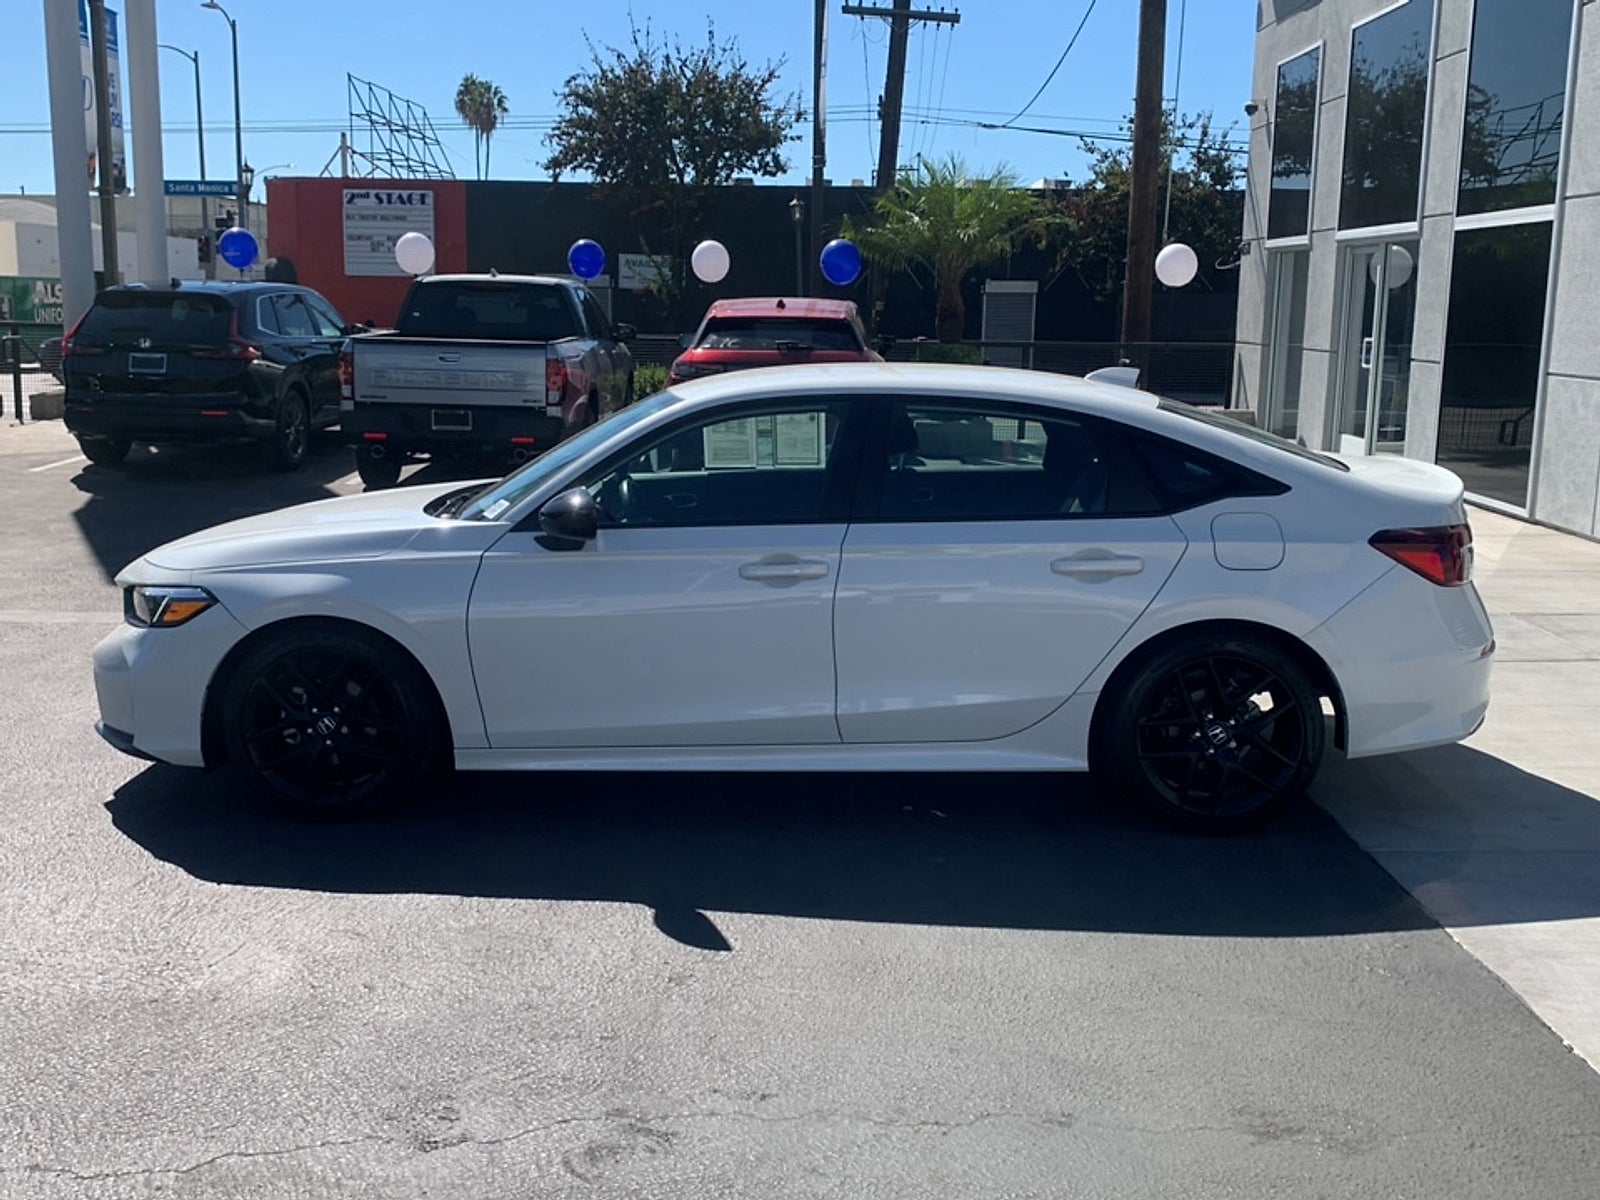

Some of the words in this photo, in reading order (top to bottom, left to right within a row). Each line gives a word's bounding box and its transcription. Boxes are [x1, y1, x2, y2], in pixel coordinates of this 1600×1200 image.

[168, 183, 194, 193] Santa
[198, 183, 229, 194] Monica
[346, 192, 370, 205] 2nd
[33, 280, 64, 304] ALS
[34, 307, 64, 323] UNIFO
